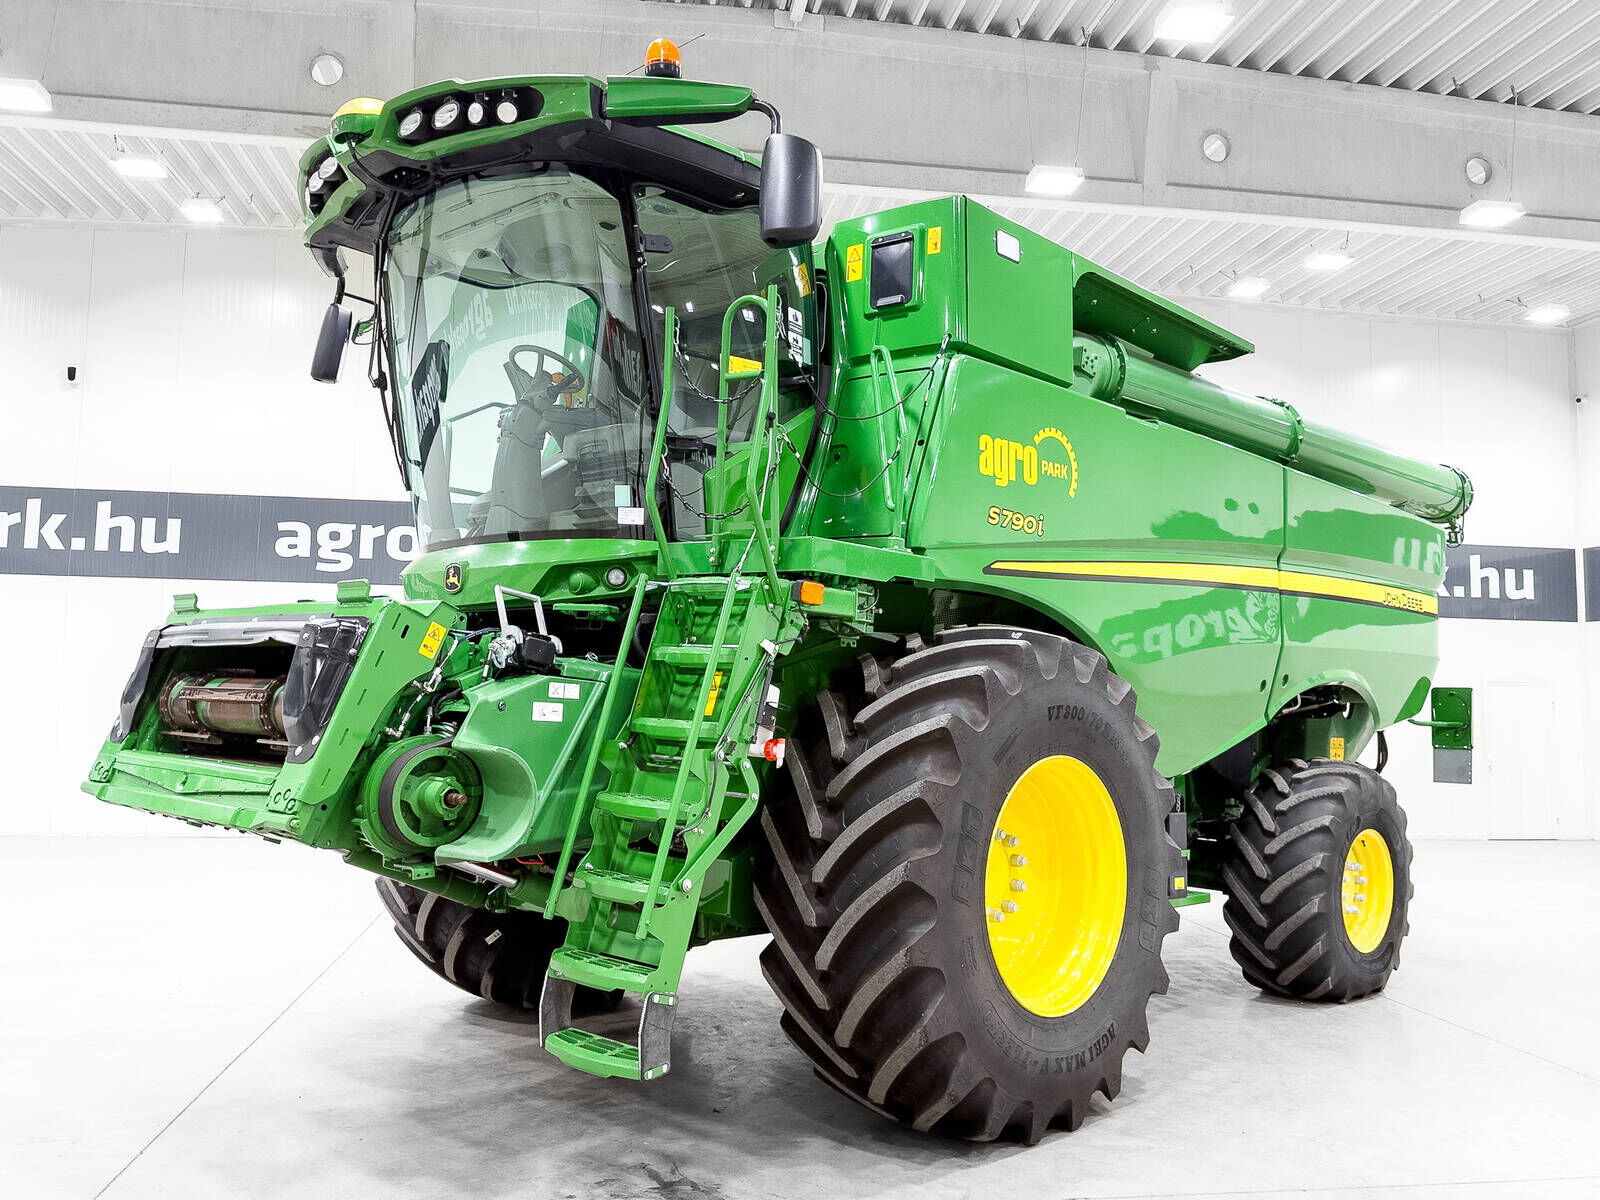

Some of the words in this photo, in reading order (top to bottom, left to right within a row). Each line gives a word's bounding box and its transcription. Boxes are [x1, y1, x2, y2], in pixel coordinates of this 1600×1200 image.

[979, 434, 1038, 487] agro
[1041, 460, 1068, 480] PARK
[987, 506, 1045, 537] S790i
[1383, 590, 1401, 609] JOHN
[1401, 592, 1423, 611] DEERE
